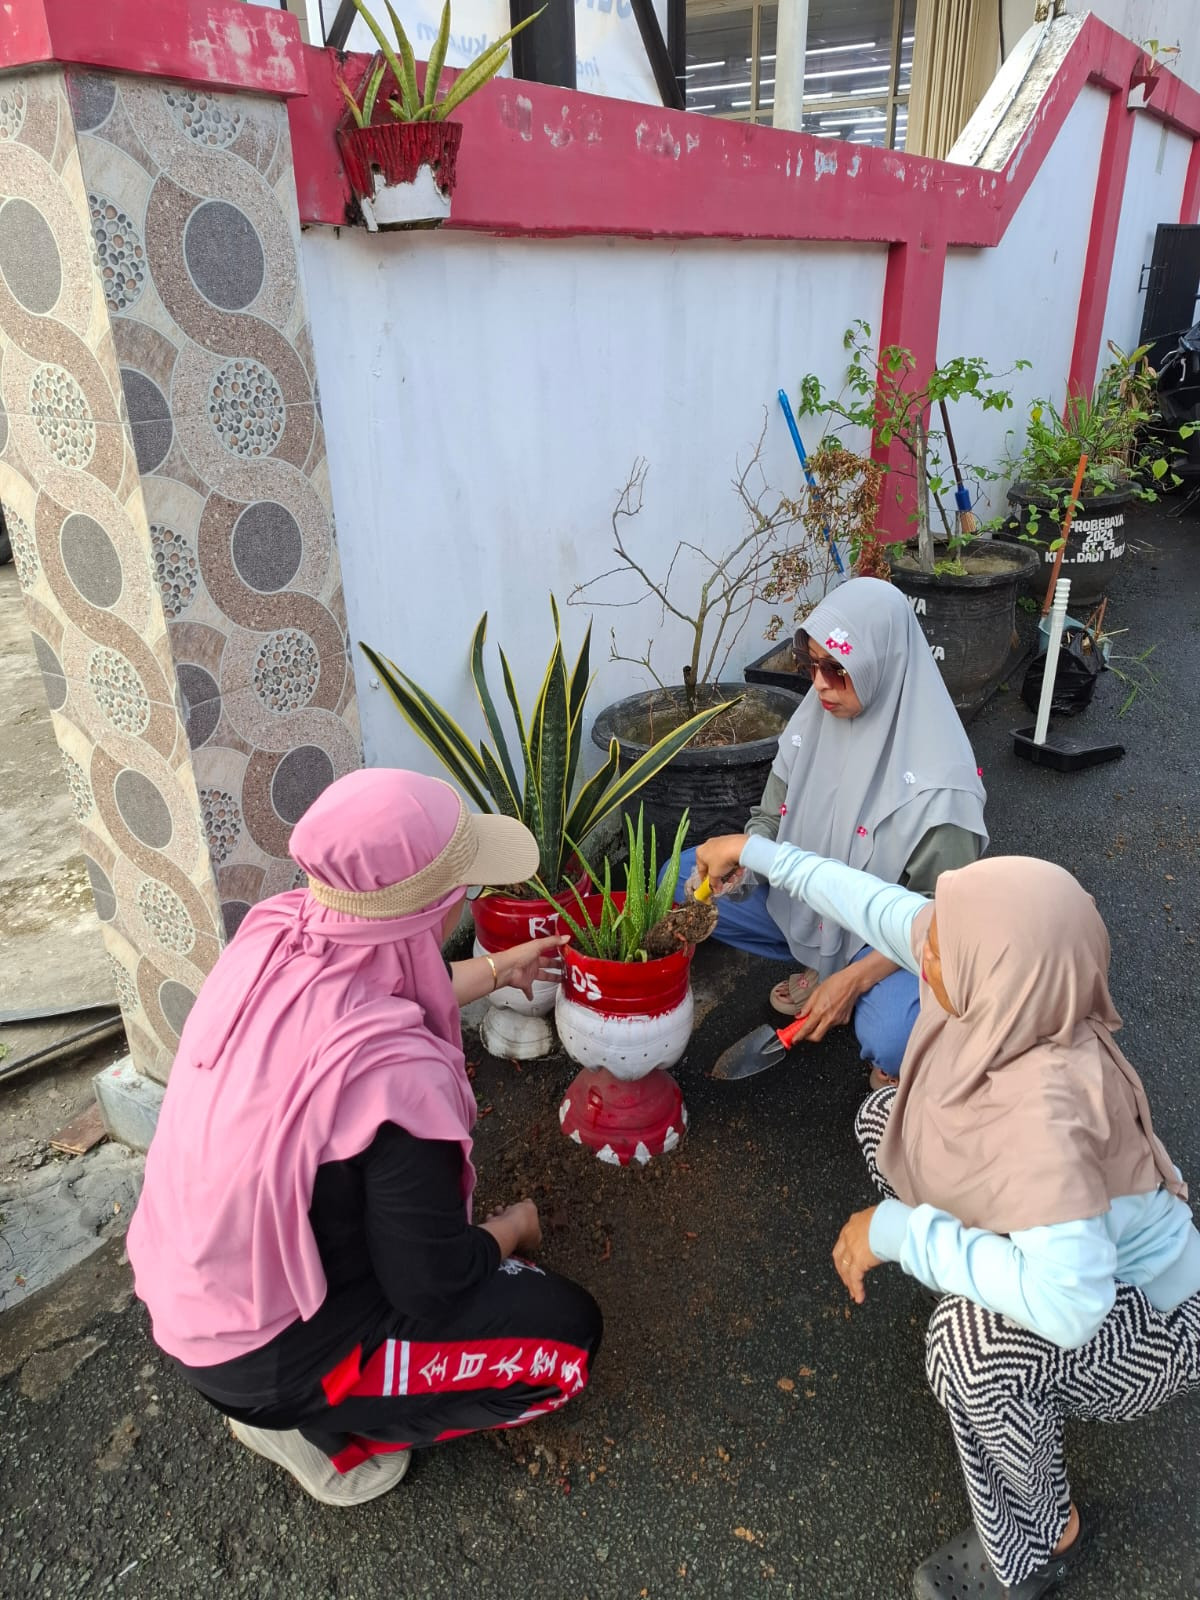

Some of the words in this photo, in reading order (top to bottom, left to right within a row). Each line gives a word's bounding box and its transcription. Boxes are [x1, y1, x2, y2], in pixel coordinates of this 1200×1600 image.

[1068, 514, 1124, 533] PROBEBAYA
[1086, 528, 1114, 543] 2024
[571, 965, 602, 1000] 05
